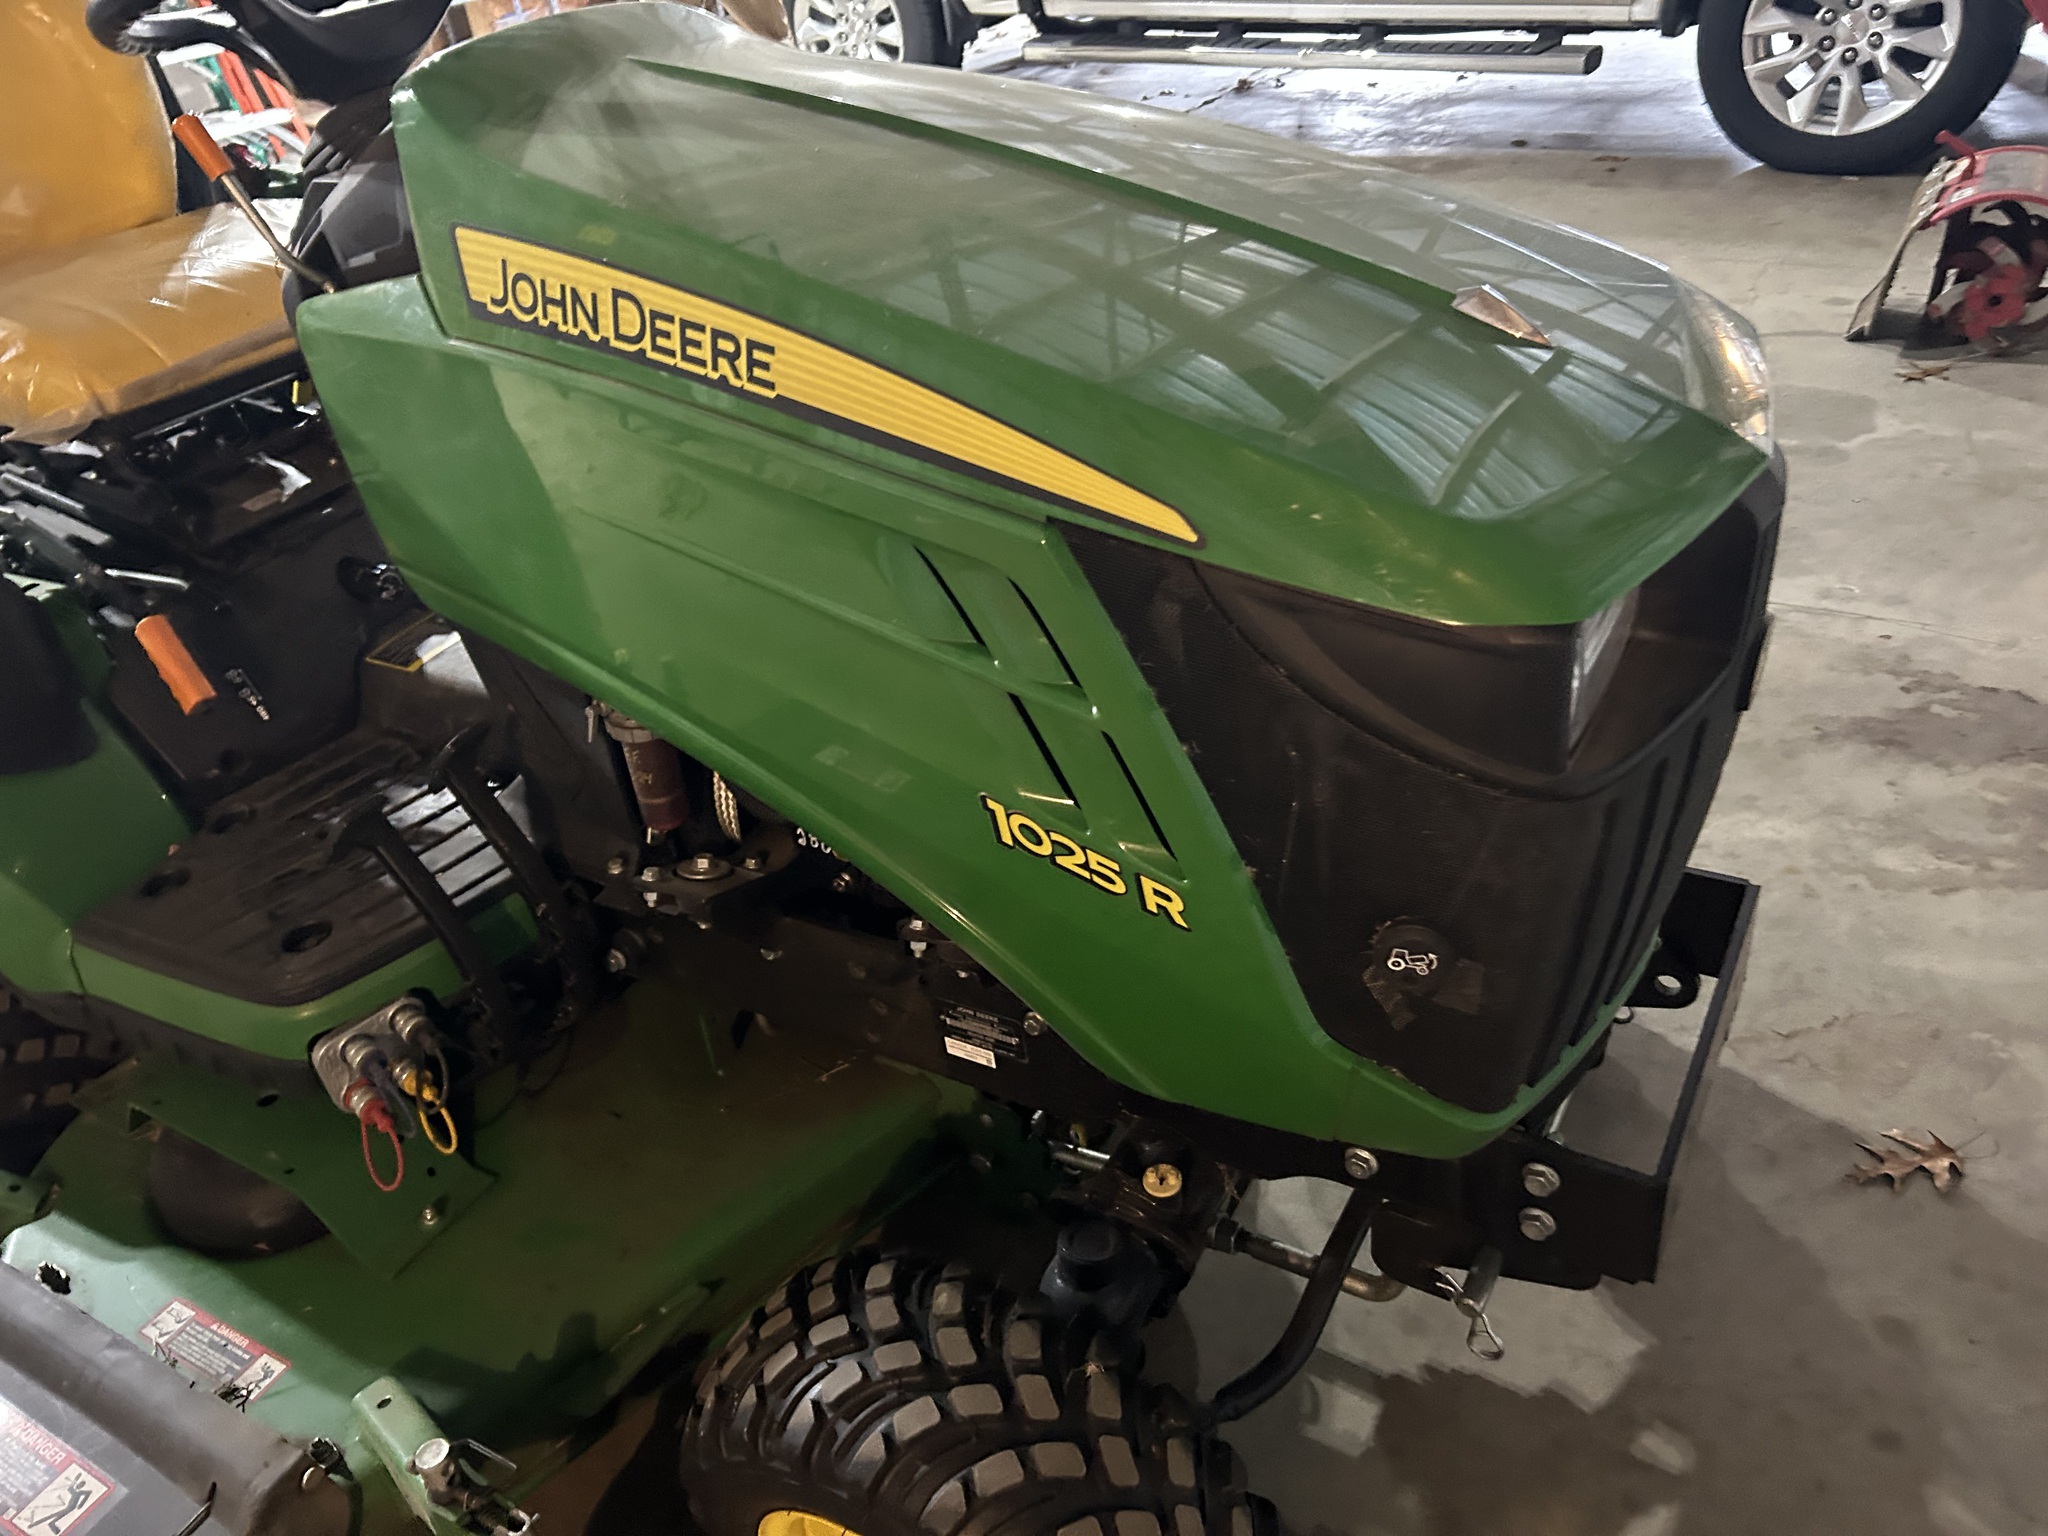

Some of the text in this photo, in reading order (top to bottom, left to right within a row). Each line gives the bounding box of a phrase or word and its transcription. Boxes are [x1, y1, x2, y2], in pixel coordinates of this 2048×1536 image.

[488, 258, 778, 397] JOHN DEERE
[978, 792, 1192, 932] 1025 R
[217, 1323, 250, 1348] DANGER
[20, 1425, 67, 1465] DANGER
